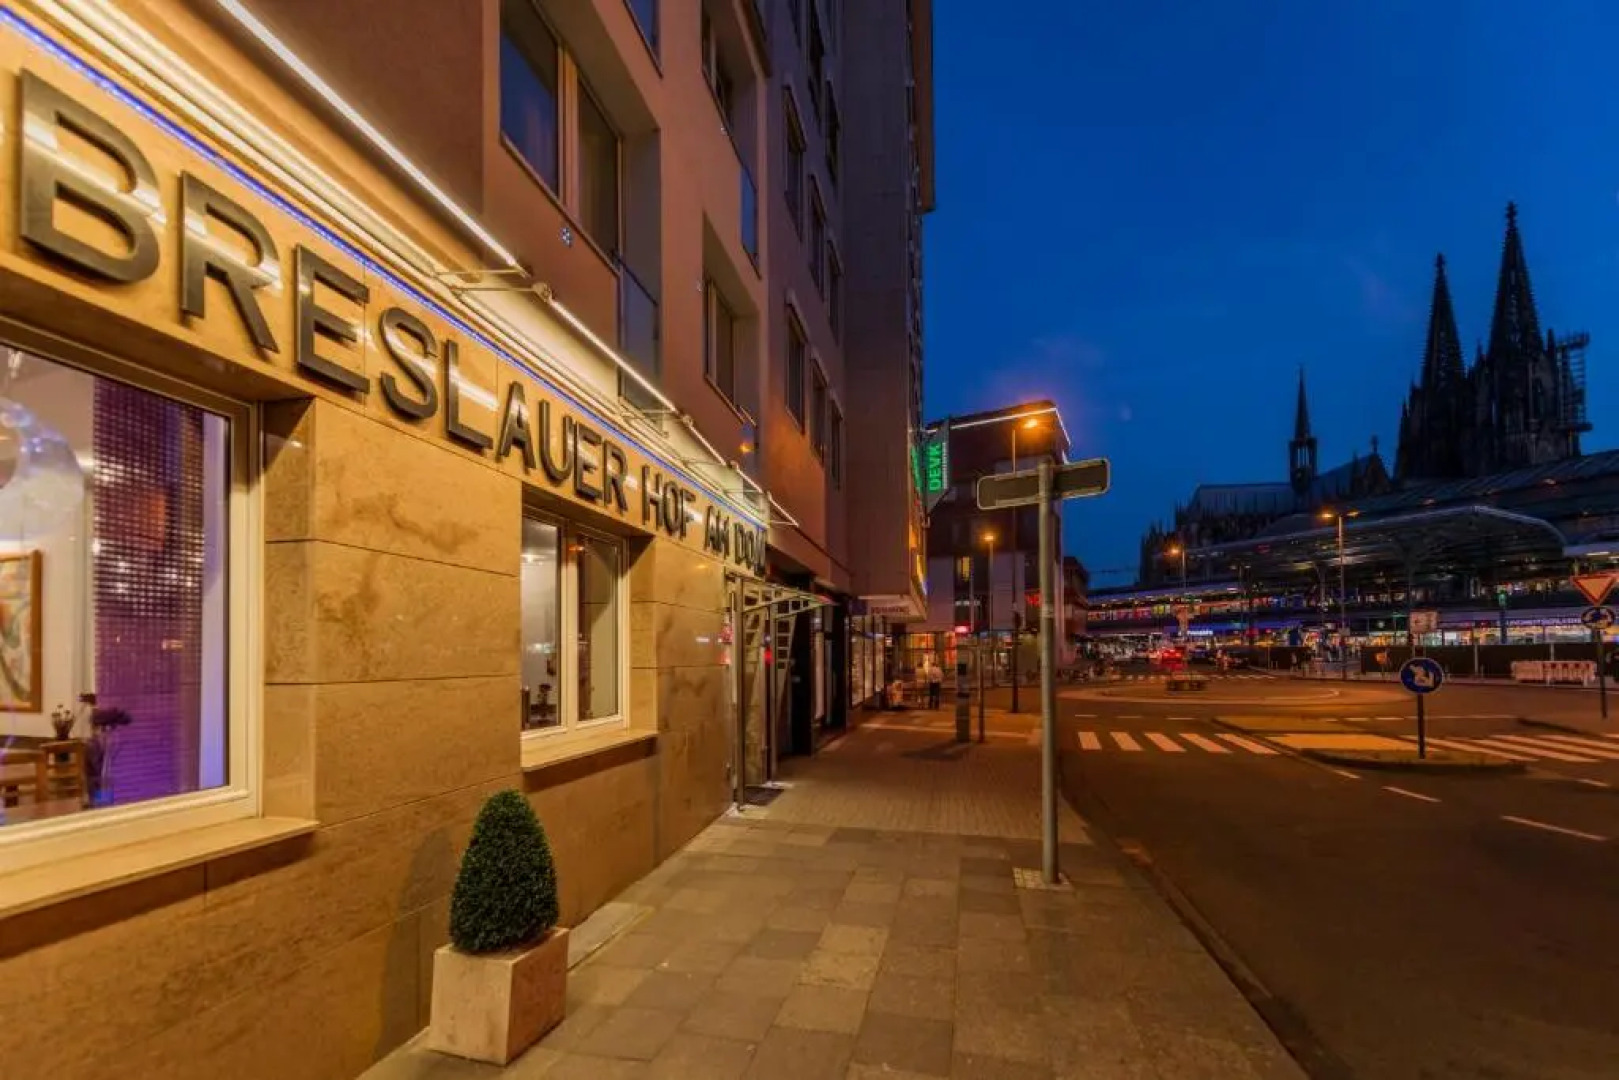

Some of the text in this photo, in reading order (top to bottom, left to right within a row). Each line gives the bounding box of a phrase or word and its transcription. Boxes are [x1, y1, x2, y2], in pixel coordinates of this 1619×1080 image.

[20, 68, 629, 515] BRESLAUER
[641, 464, 697, 541] HOF
[704, 505, 730, 560] AM
[929, 442, 942, 491] DEVK
